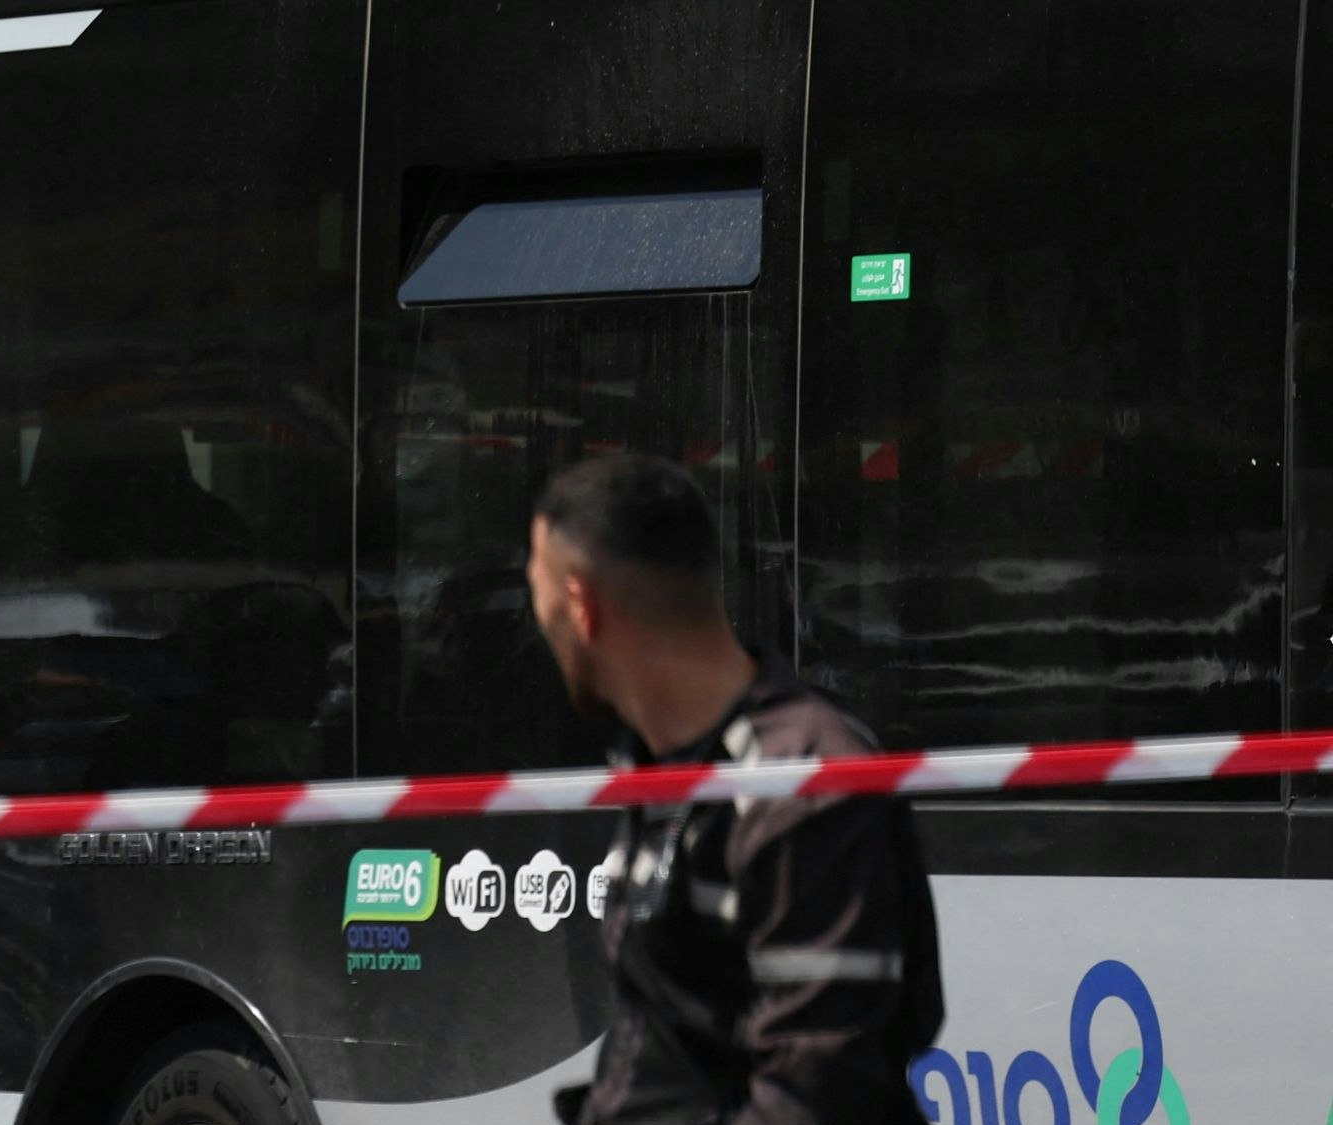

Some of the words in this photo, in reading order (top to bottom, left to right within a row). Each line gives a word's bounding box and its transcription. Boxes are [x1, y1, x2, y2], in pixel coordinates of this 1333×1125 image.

[59, 832, 159, 865] GOLDEN
[165, 830, 273, 865] DRAGON
[520, 874, 544, 894] USB
[347, 926, 410, 949] סופרבוס
